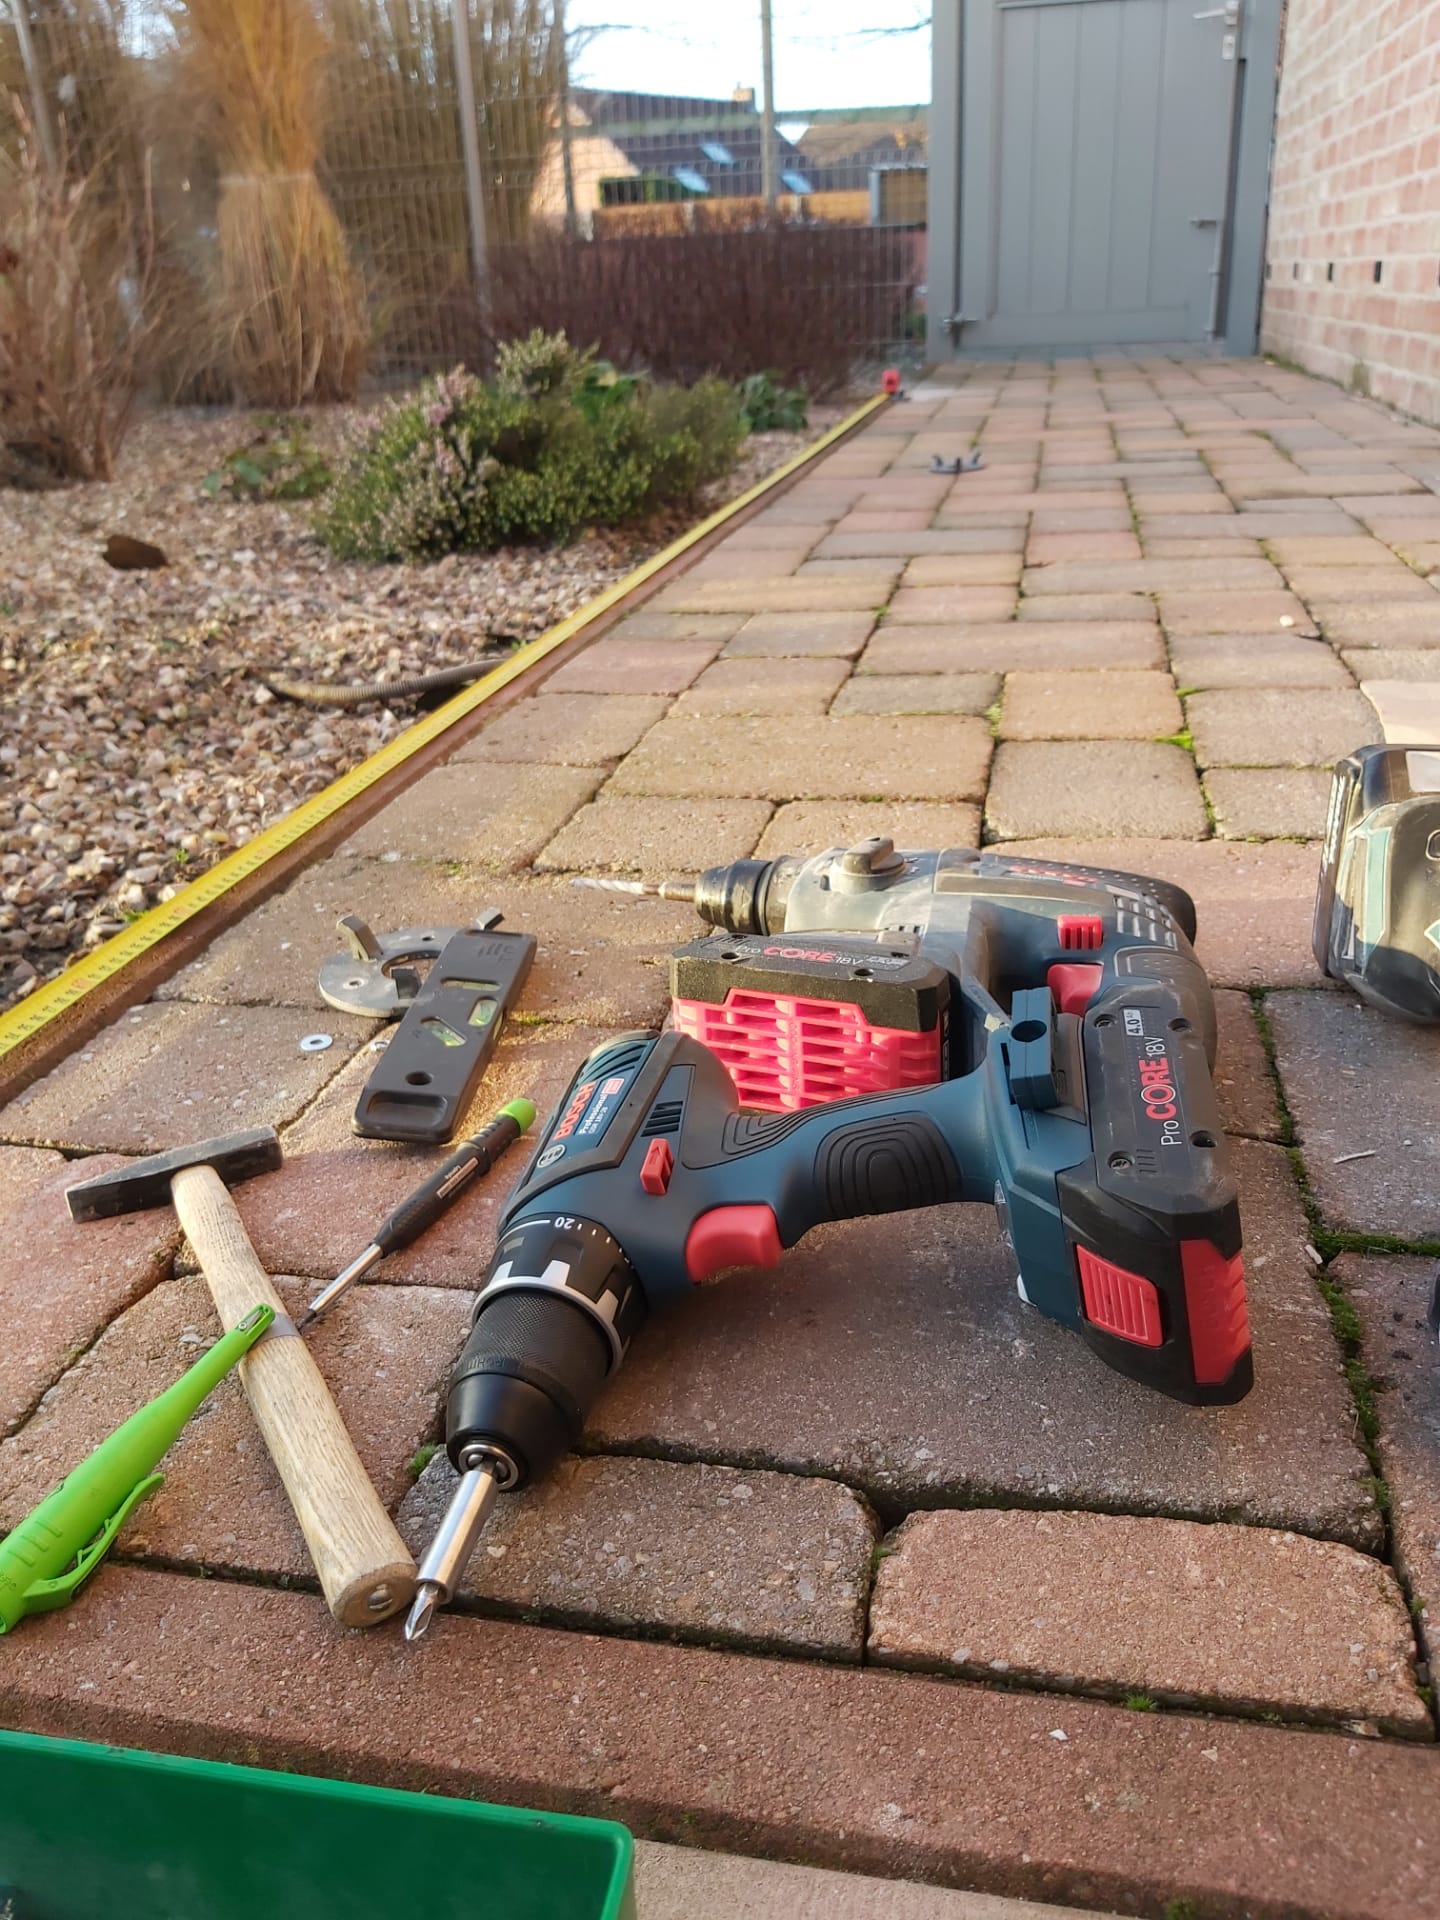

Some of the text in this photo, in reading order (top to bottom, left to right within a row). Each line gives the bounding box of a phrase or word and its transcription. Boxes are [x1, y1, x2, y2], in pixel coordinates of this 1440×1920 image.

[763, 946, 836, 963] CORE
[835, 955, 864, 966] 18V
[1126, 1018, 1143, 1035] 4.0
[1138, 1036, 1183, 1146] Pro CORE 18V
[554, 1081, 598, 1140] BOSCH
[554, 1216, 576, 1230] 20
